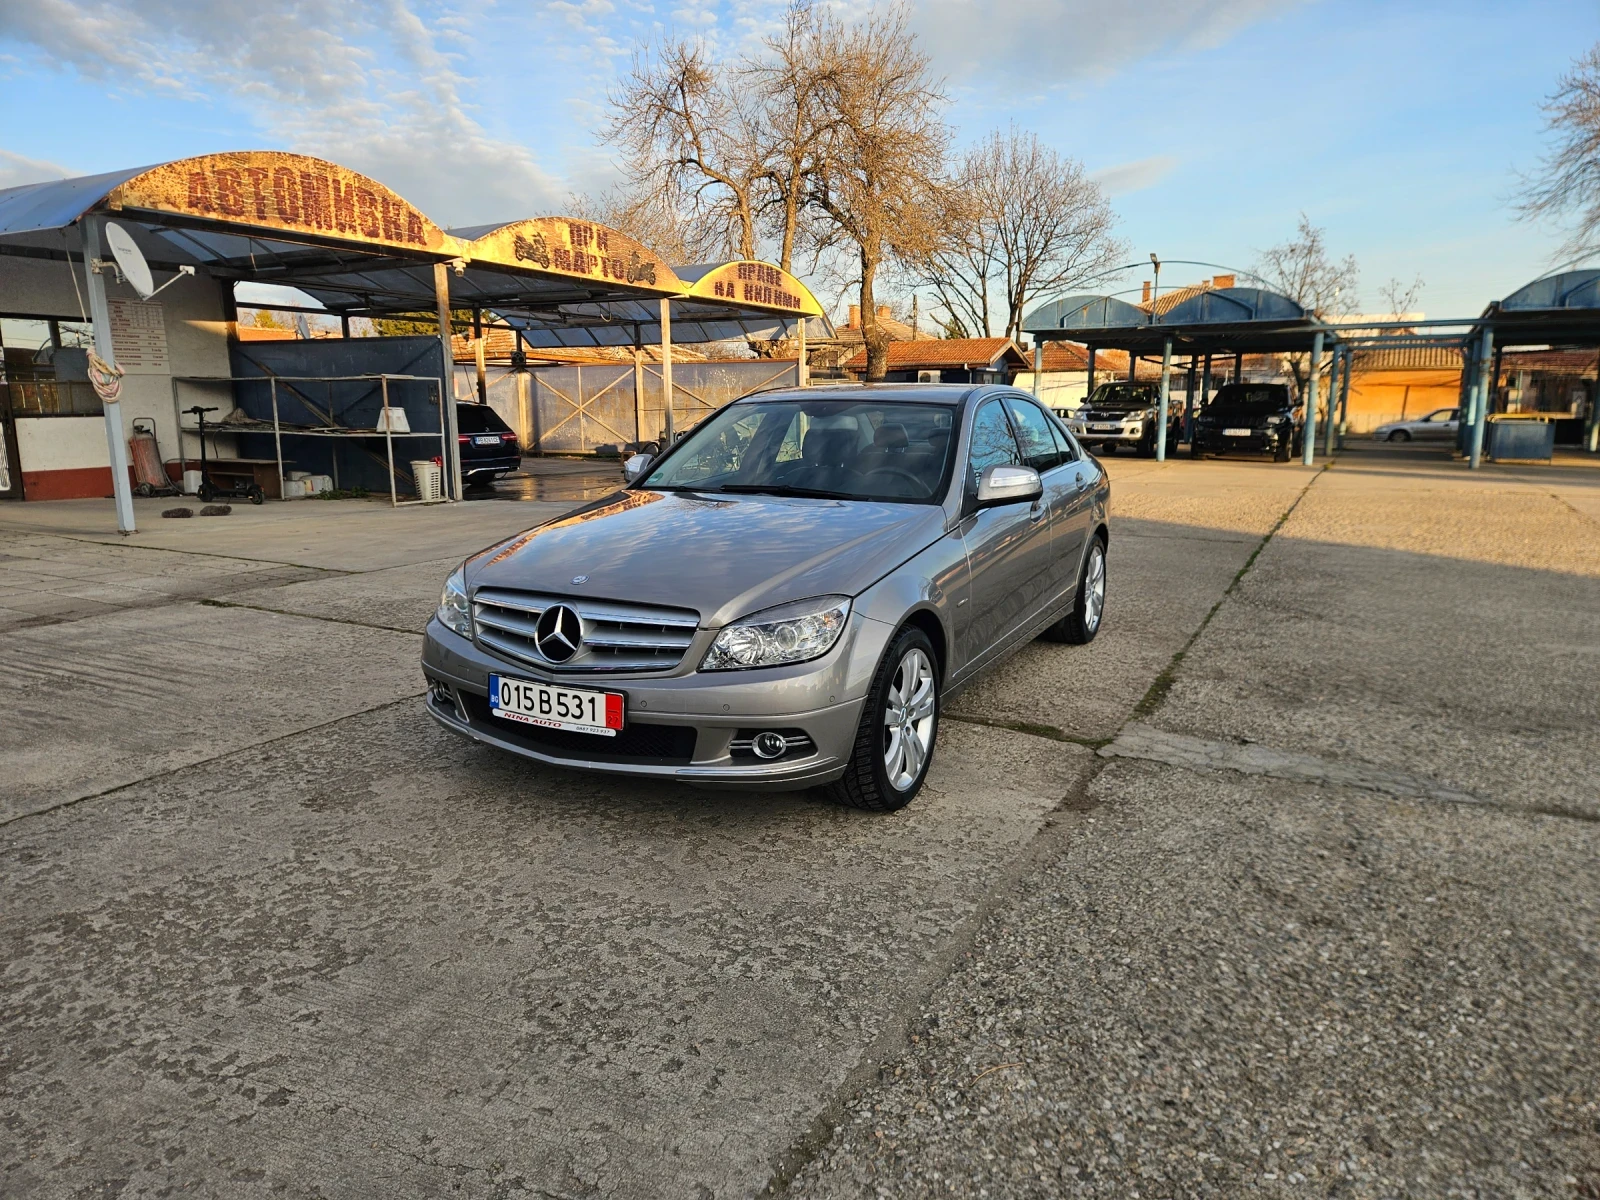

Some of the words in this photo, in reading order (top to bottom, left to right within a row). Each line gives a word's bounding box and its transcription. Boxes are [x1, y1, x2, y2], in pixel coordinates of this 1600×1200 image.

[187, 166, 427, 246] АВТОМИВКА
[738, 262, 782, 287] ПРАНЕ
[714, 281, 735, 299] НА
[744, 283, 801, 310] КИЛИМИ
[491, 694, 499, 703] BG
[504, 712, 529, 723] NINA
[532, 718, 562, 728] AUTO
